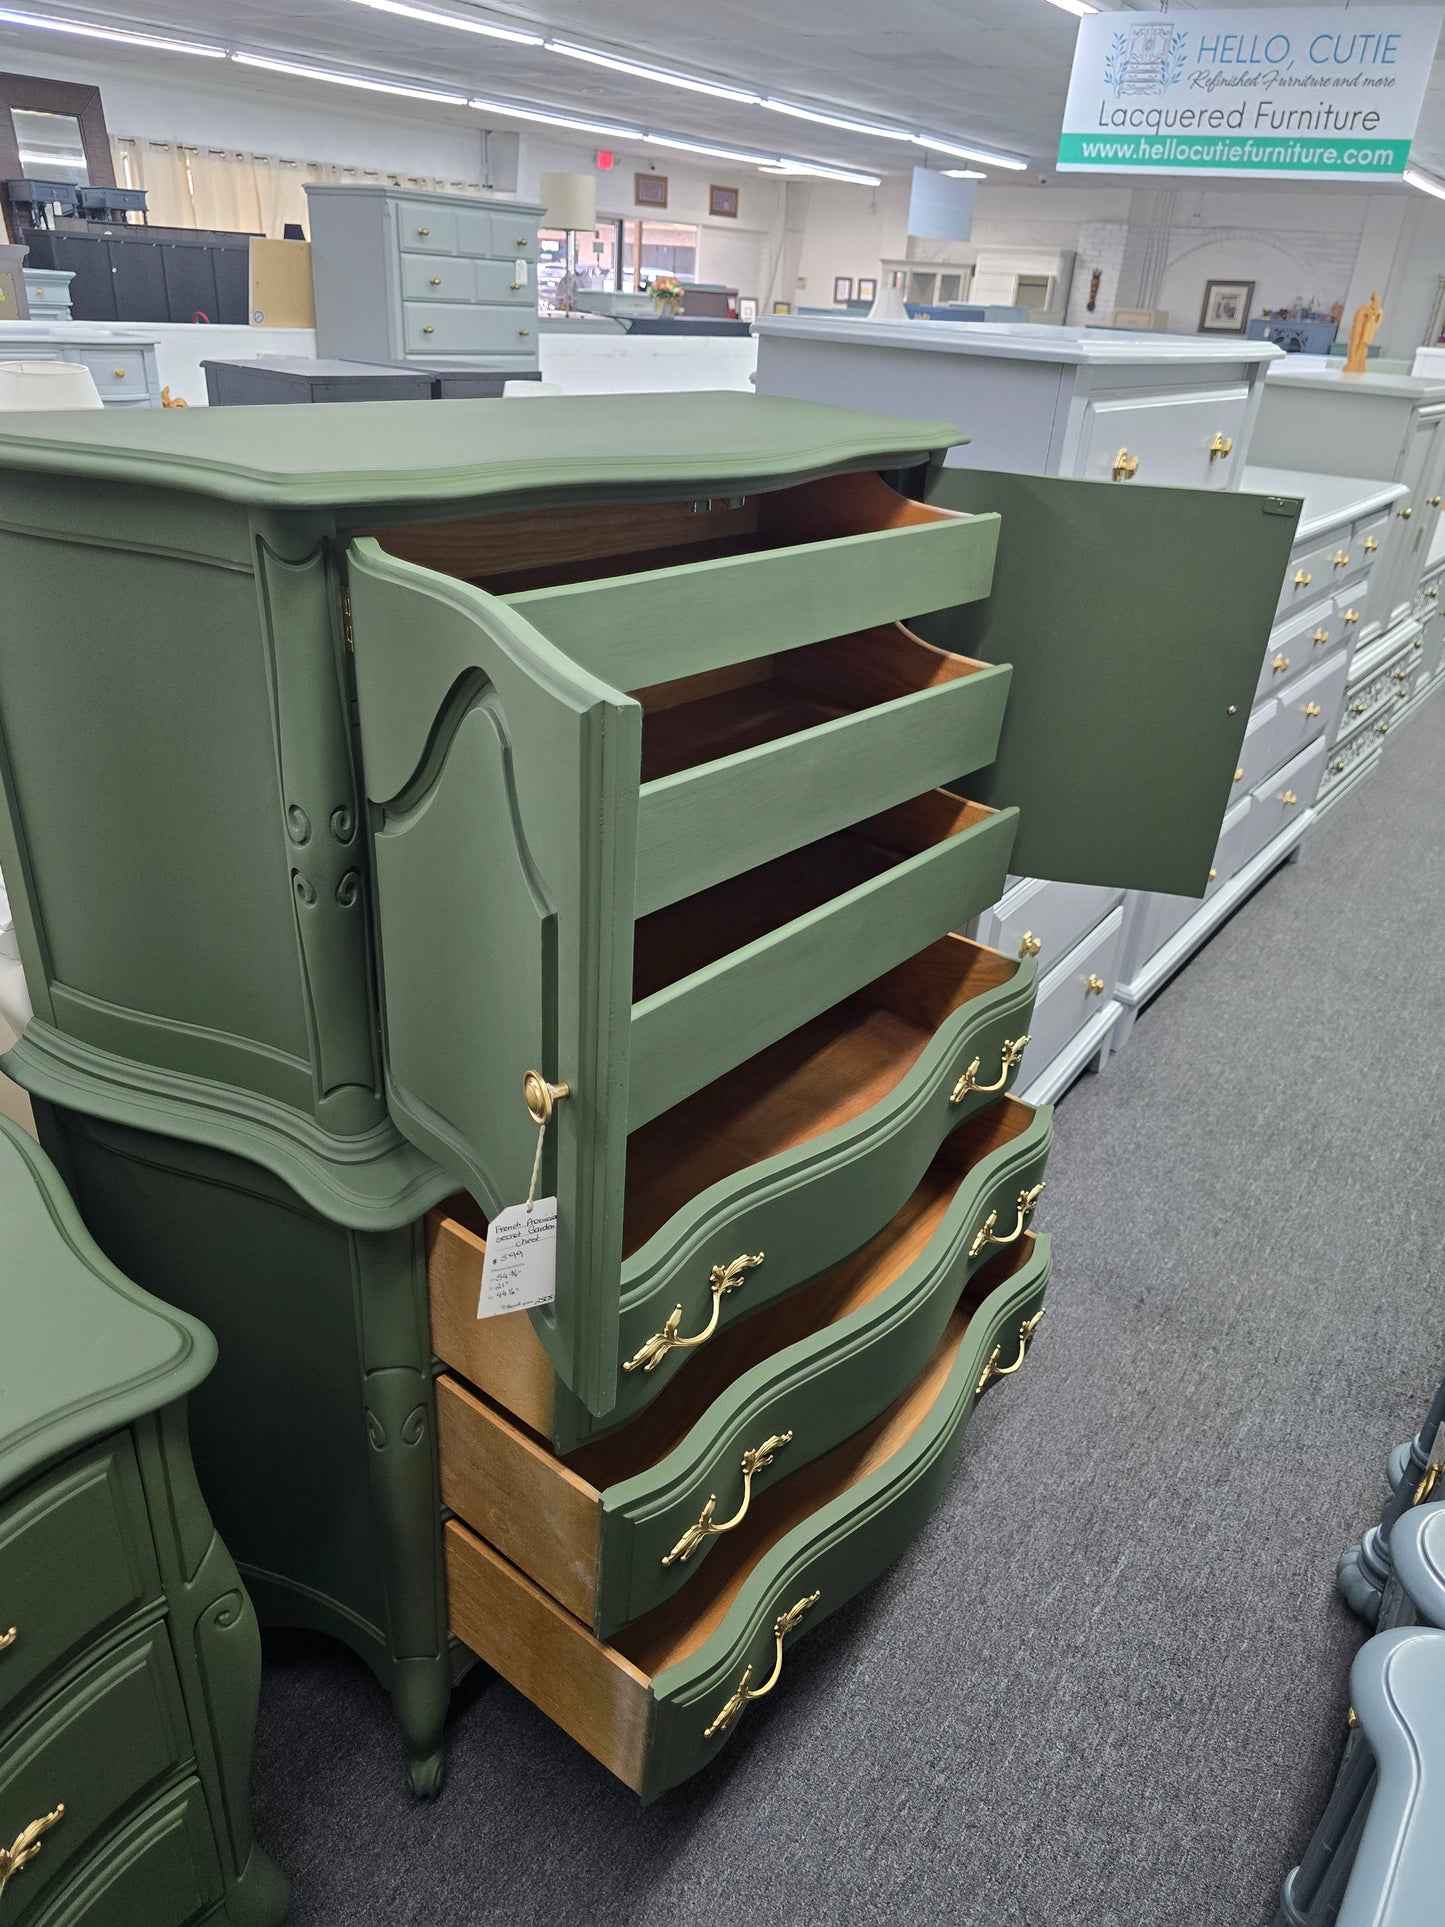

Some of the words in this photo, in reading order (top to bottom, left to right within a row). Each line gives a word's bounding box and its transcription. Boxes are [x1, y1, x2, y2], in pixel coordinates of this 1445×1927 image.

[1197, 34, 1294, 71] HELLO,
[1309, 33, 1402, 65] CUTIE
[1188, 70, 1261, 90] Refinished
[1262, 69, 1331, 89] Furniture
[1332, 71, 1360, 88] and
[1361, 77, 1397, 88] more
[1099, 100, 1245, 136] Lacquered
[1254, 101, 1381, 132] Furniture
[1081, 139, 1395, 166] www.hellocutiefurniture.com
